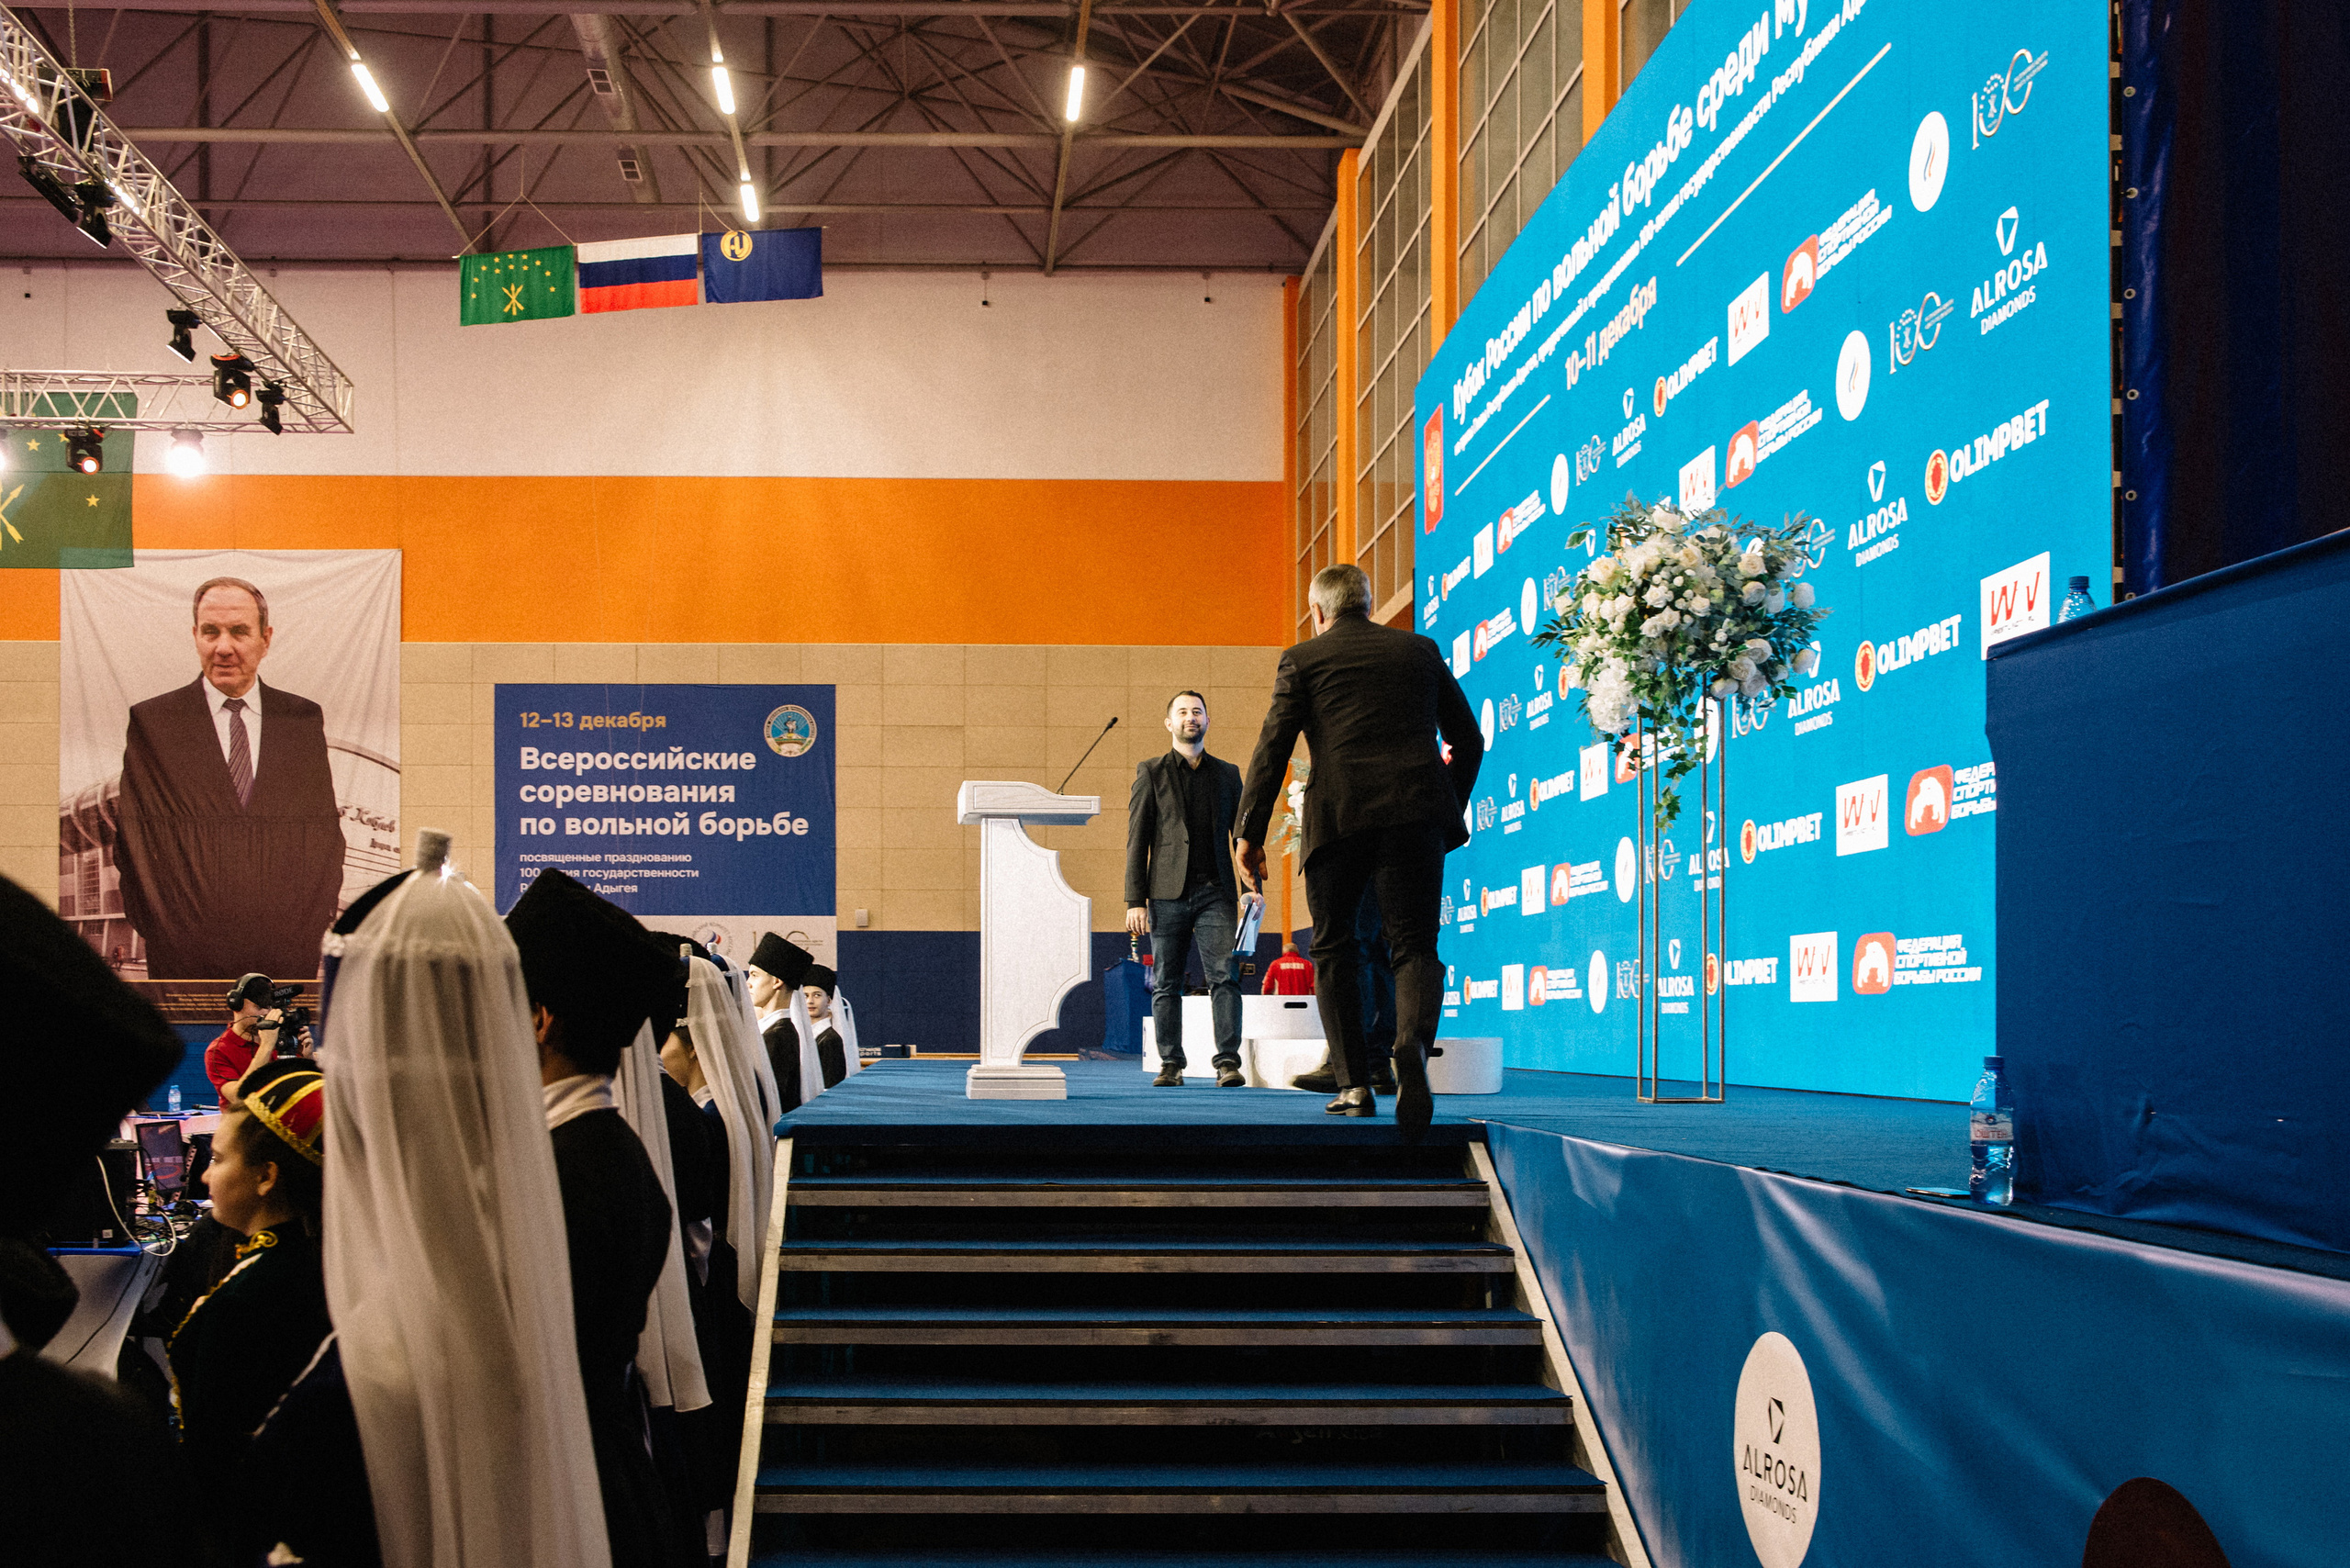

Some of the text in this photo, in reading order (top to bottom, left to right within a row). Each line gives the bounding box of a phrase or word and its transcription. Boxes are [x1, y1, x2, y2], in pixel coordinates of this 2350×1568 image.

[1453, 357, 1485, 425] Кубок
[1486, 301, 1531, 379] России
[1532, 279, 1551, 324] по
[1552, 182, 1620, 300] вольной
[1622, 104, 1694, 216] борьбе
[1696, 11, 1769, 131] среди
[1970, 241, 2048, 319] ALROSA
[1599, 275, 1657, 365] декабря
[1980, 286, 2036, 335] DIAMONDS
[1666, 336, 1718, 399] OLIMPBET
[1612, 413, 1646, 456] ALROSA
[1949, 398, 2049, 482] OLIMPBET
[1847, 497, 1908, 551] ALROSA
[1855, 533, 1899, 567] DIAMONDS
[1876, 614, 1962, 675] OLIMPBET
[1787, 678, 1841, 719] ALROSA
[579, 711, 666, 733] декабря
[520, 746, 756, 776] Всероссийские
[520, 784, 735, 809] соревнования
[520, 812, 809, 842] по вольной борьбе
[1757, 812, 1823, 853] OLIMPBET
[520, 854, 692, 865] посвященные празднованию
[582, 868, 699, 879] государственности
[594, 882, 638, 895] Адыгея
[1935, 967, 1983, 983] РОССИИ
[1743, 1444, 1807, 1503] ALROSA
[1750, 1484, 1797, 1524] DIAMONDS
